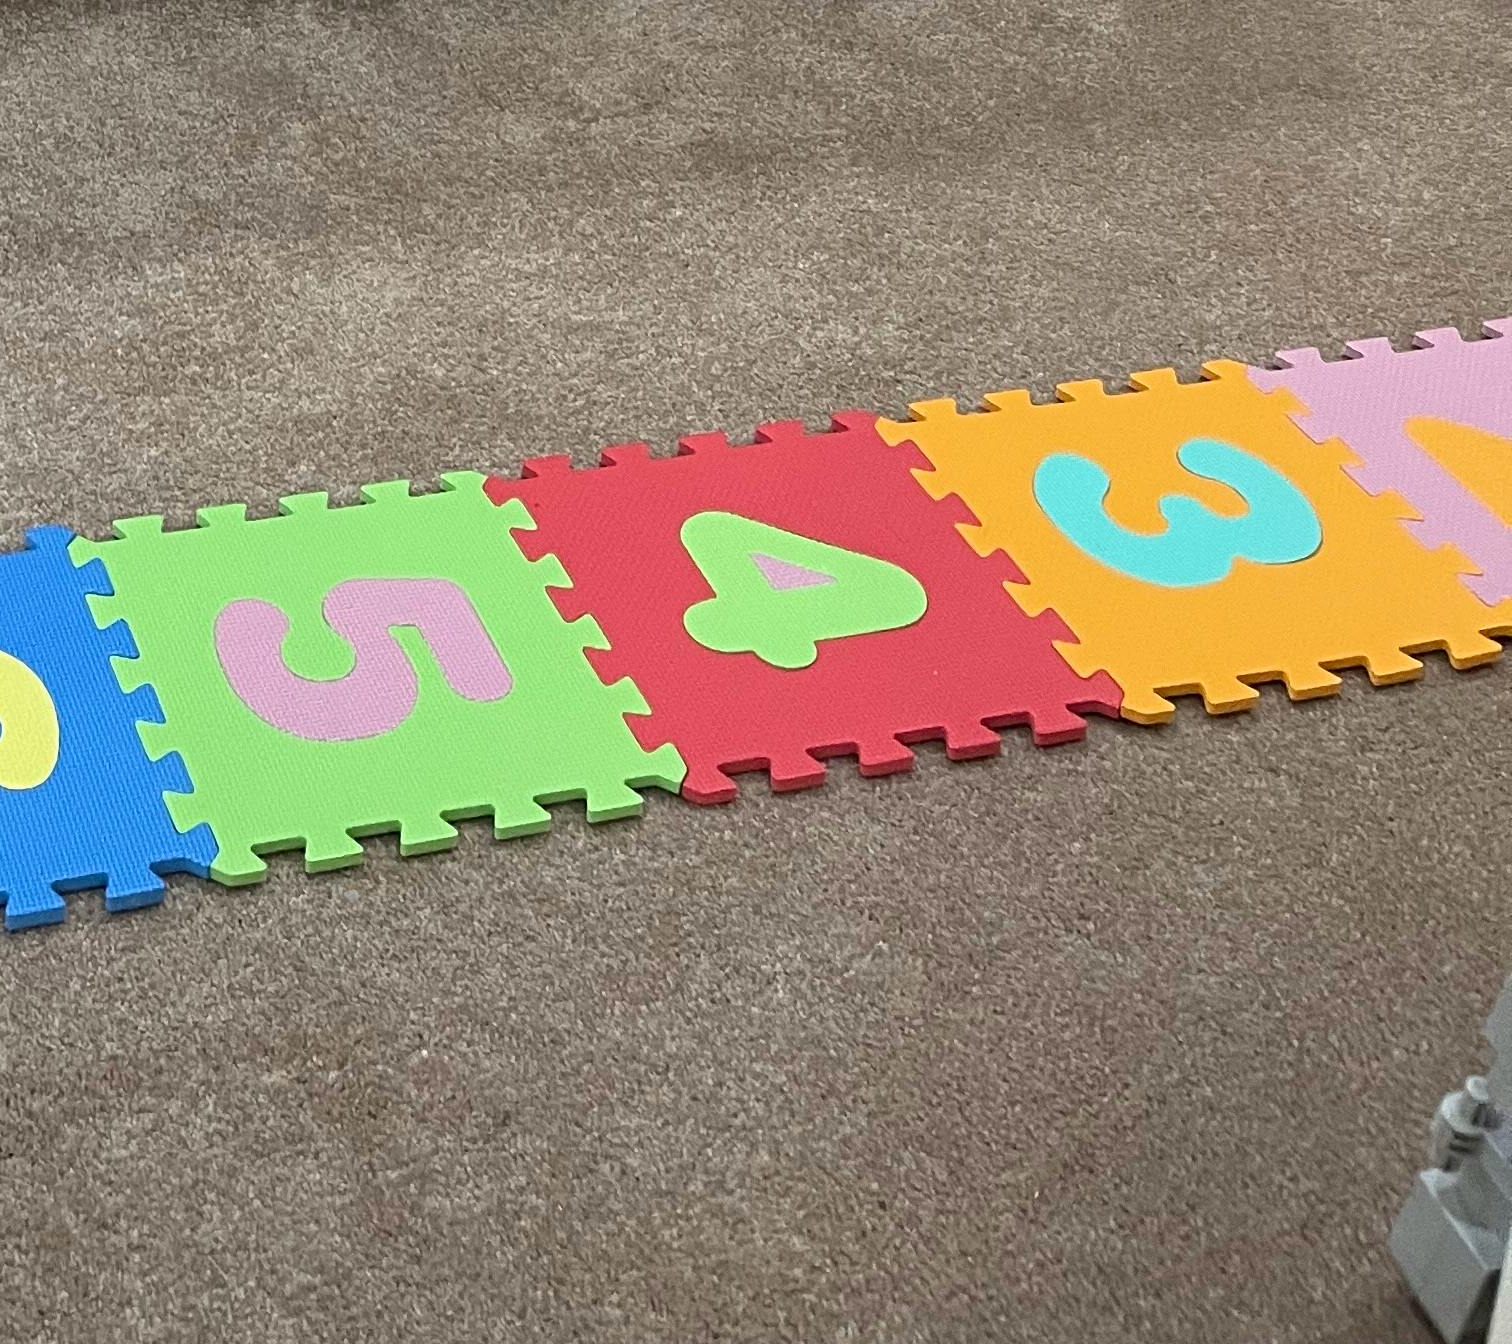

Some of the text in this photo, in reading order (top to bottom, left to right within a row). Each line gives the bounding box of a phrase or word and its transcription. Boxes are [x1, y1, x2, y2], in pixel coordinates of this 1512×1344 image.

[680, 511, 928, 669] 4
[1033, 438, 1323, 587] 3
[214, 578, 513, 742] 5
